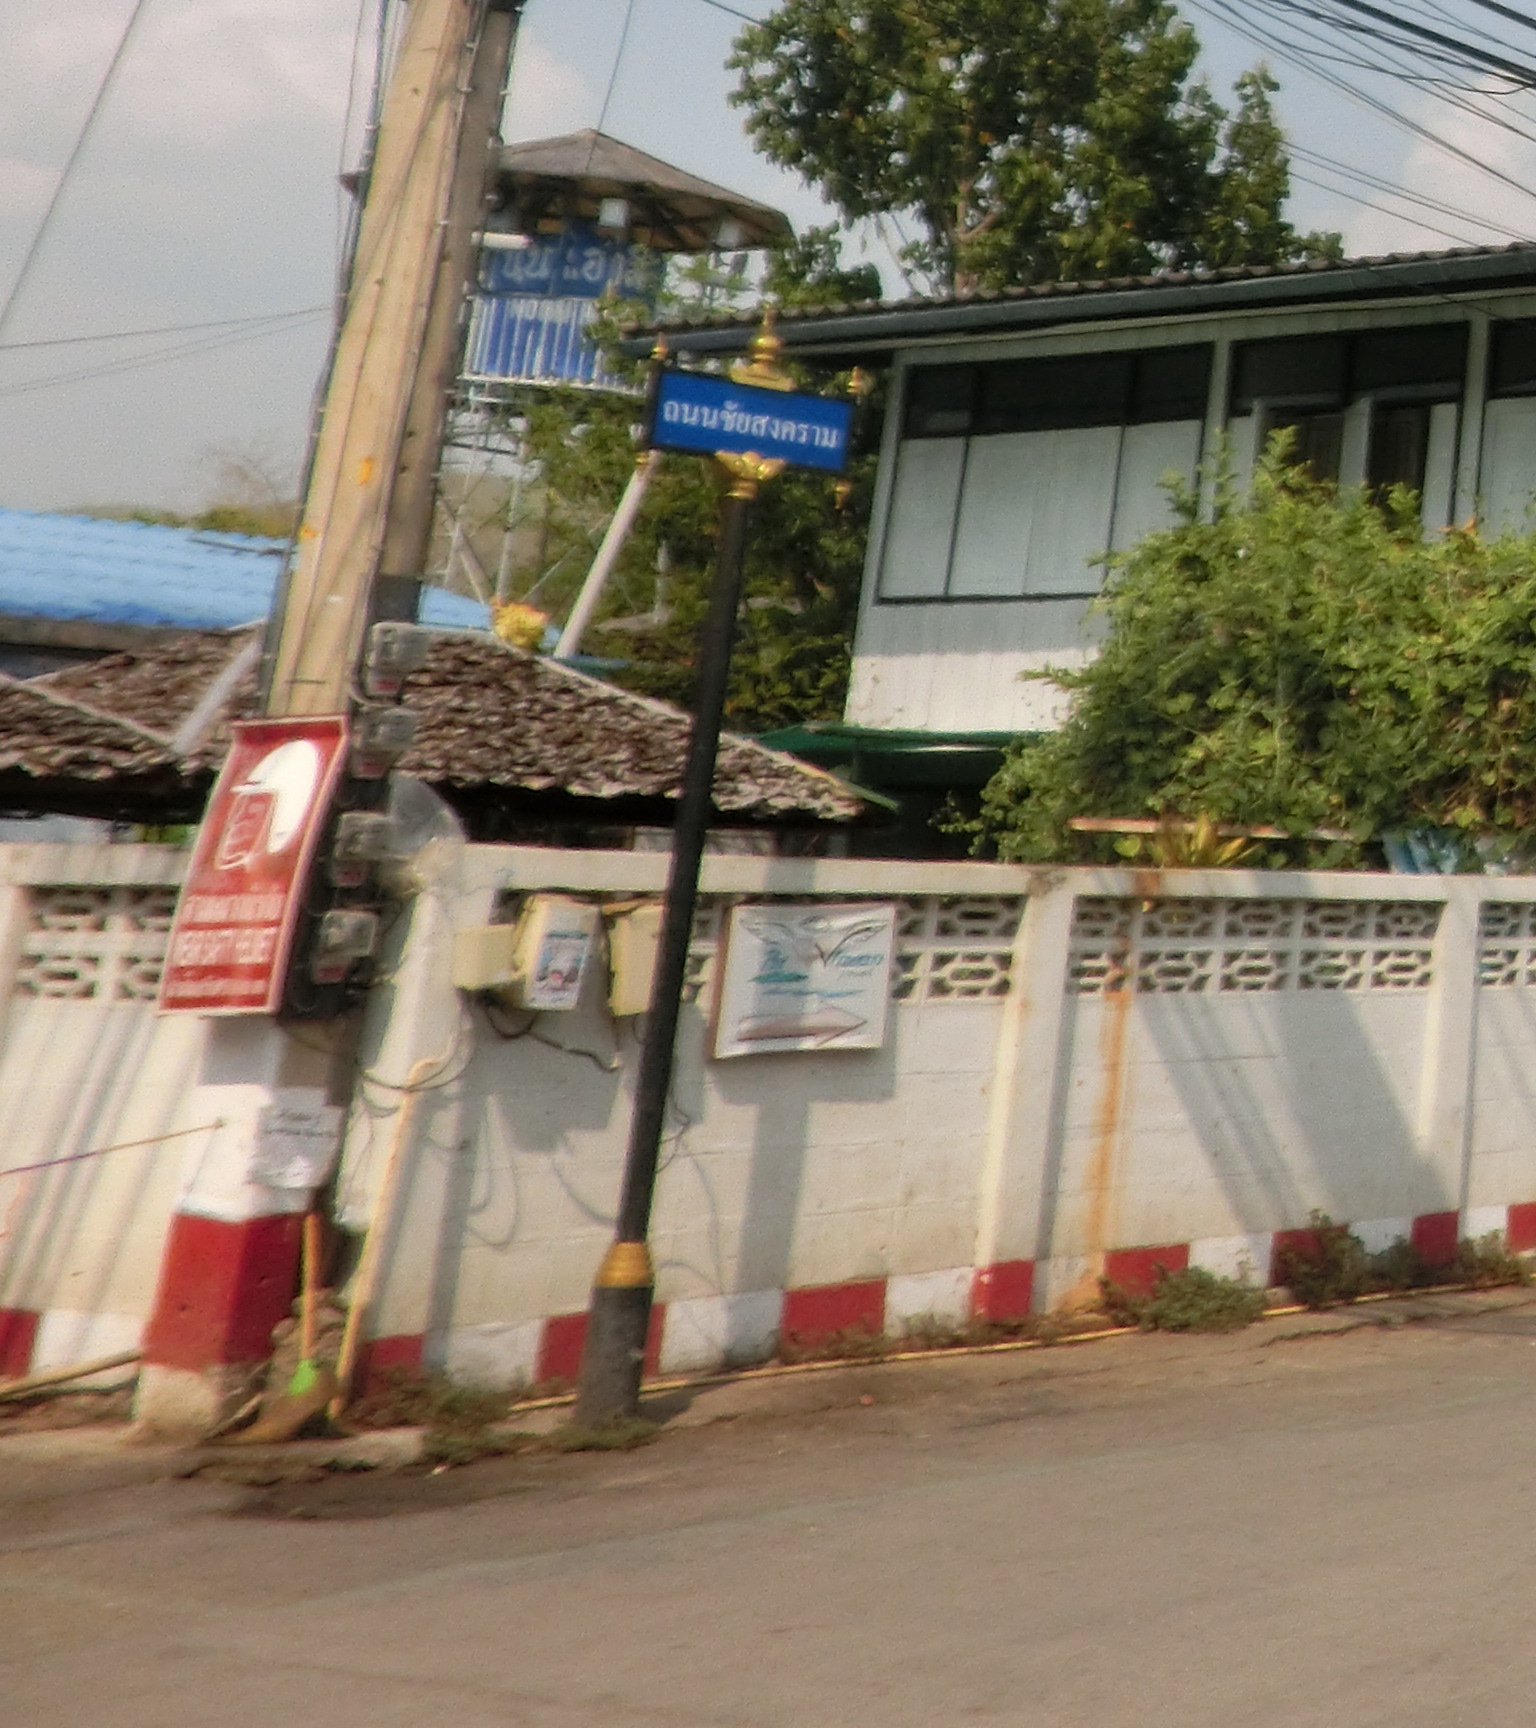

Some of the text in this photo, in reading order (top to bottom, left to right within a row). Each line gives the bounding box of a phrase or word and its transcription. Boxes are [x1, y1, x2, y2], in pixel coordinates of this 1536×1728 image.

[662, 399, 838, 448] ถนนชัยสงคราม
